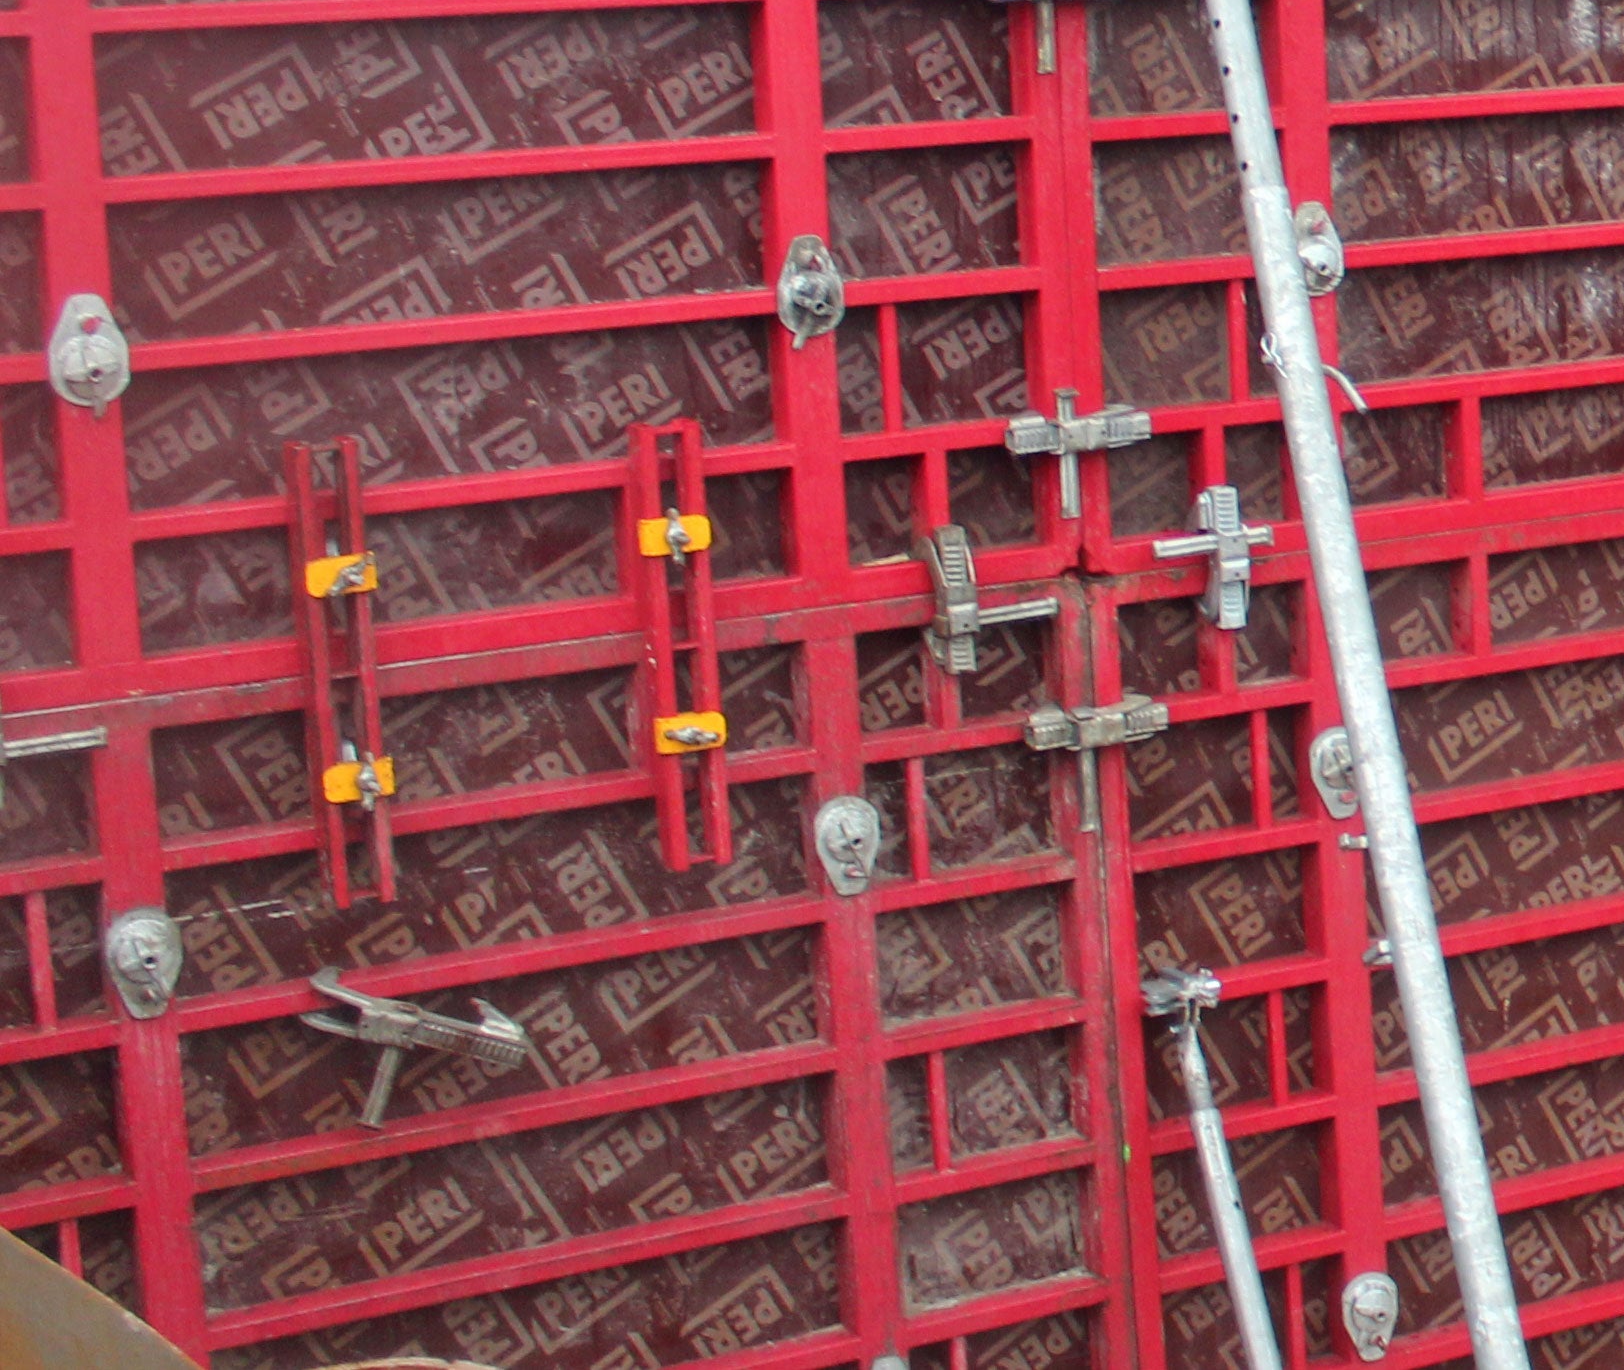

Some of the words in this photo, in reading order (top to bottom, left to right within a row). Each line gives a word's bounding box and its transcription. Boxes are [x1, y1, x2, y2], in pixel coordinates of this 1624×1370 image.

[499, 23, 593, 100] PERI
[204, 68, 309, 150] PERI
[159, 213, 265, 294] PERI
[1106, 175, 1167, 260] PER
[614, 235, 710, 299] PERI
[922, 307, 1018, 381] PERI
[1141, 298, 1217, 360] PERI
[1384, 279, 1434, 342] ERI
[573, 362, 672, 437] PERI
[708, 330, 770, 405] ERI
[1489, 569, 1548, 630] PER
[860, 662, 927, 730] PER
[1440, 692, 1517, 762] PERI
[241, 728, 308, 814] PER
[547, 841, 626, 930] PERI
[1210, 873, 1275, 960] PERI
[575, 1123, 667, 1193] PERI
[730, 1109, 819, 1189] PERI
[371, 1176, 473, 1261] PERI
[954, 1218, 1015, 1282] PER
[692, 1285, 784, 1358] PERI
